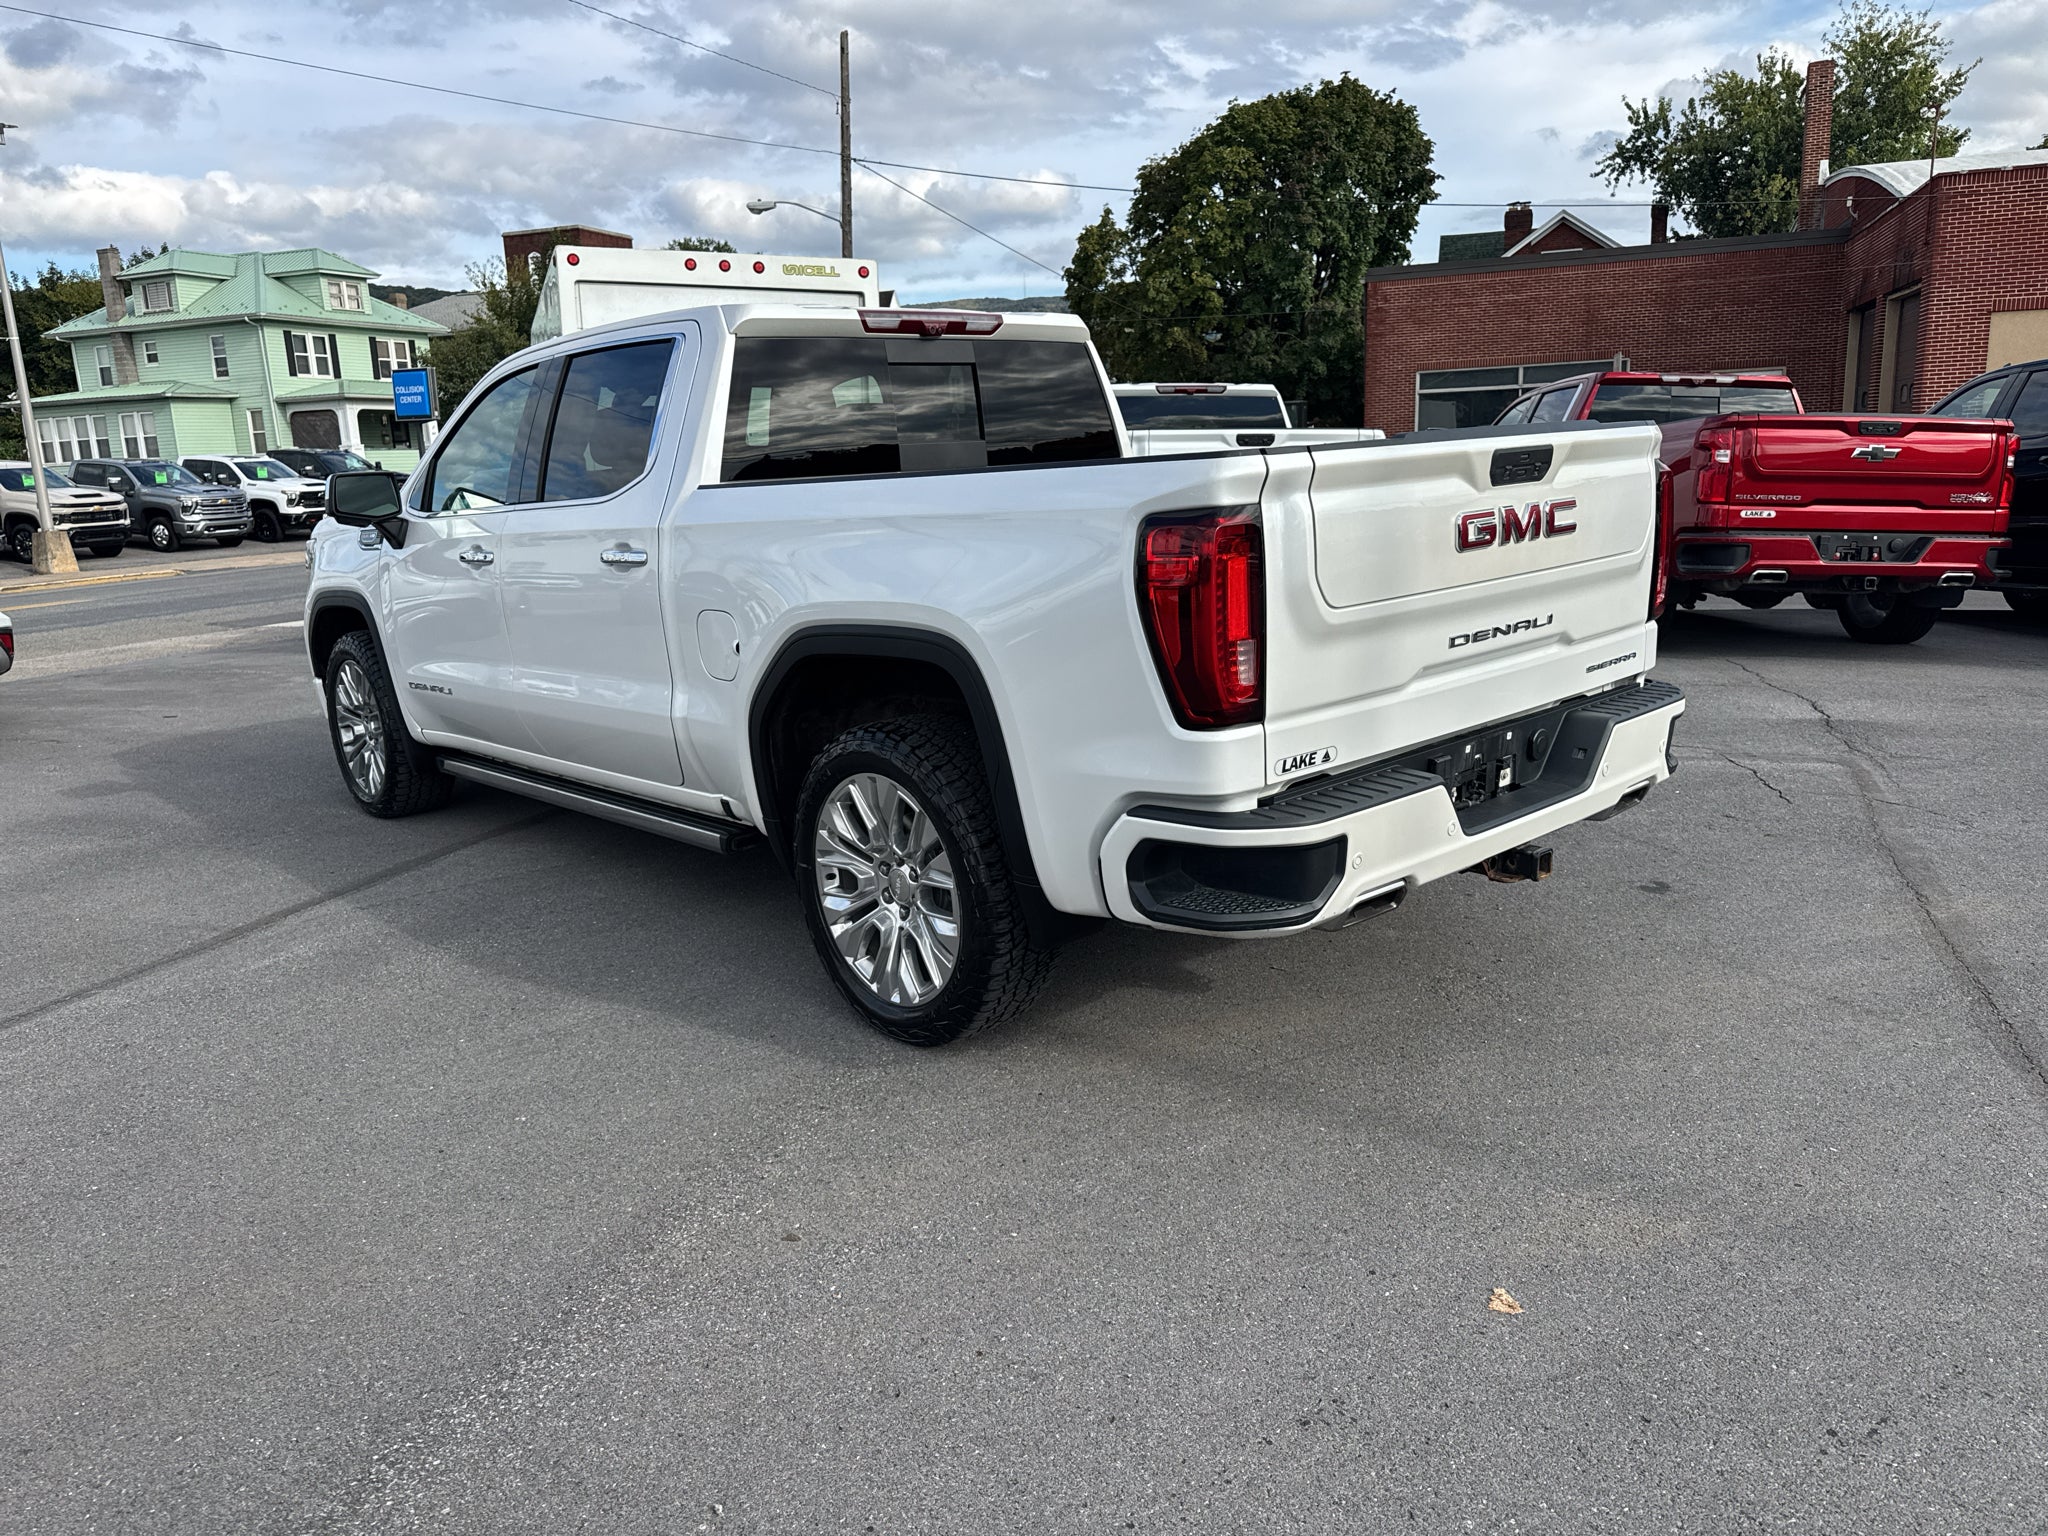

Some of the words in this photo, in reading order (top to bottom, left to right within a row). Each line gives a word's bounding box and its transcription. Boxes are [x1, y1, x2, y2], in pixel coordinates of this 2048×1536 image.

[783, 264, 840, 277] UNICELL
[395, 385, 424, 393] COLLISION
[400, 395, 422, 403] CENTER
[1455, 497, 1578, 553] GMC
[1448, 613, 1554, 650] DENALI
[1585, 652, 1637, 674] SIERRA
[408, 681, 453, 696] DENALI
[1281, 751, 1318, 774] LAKE
